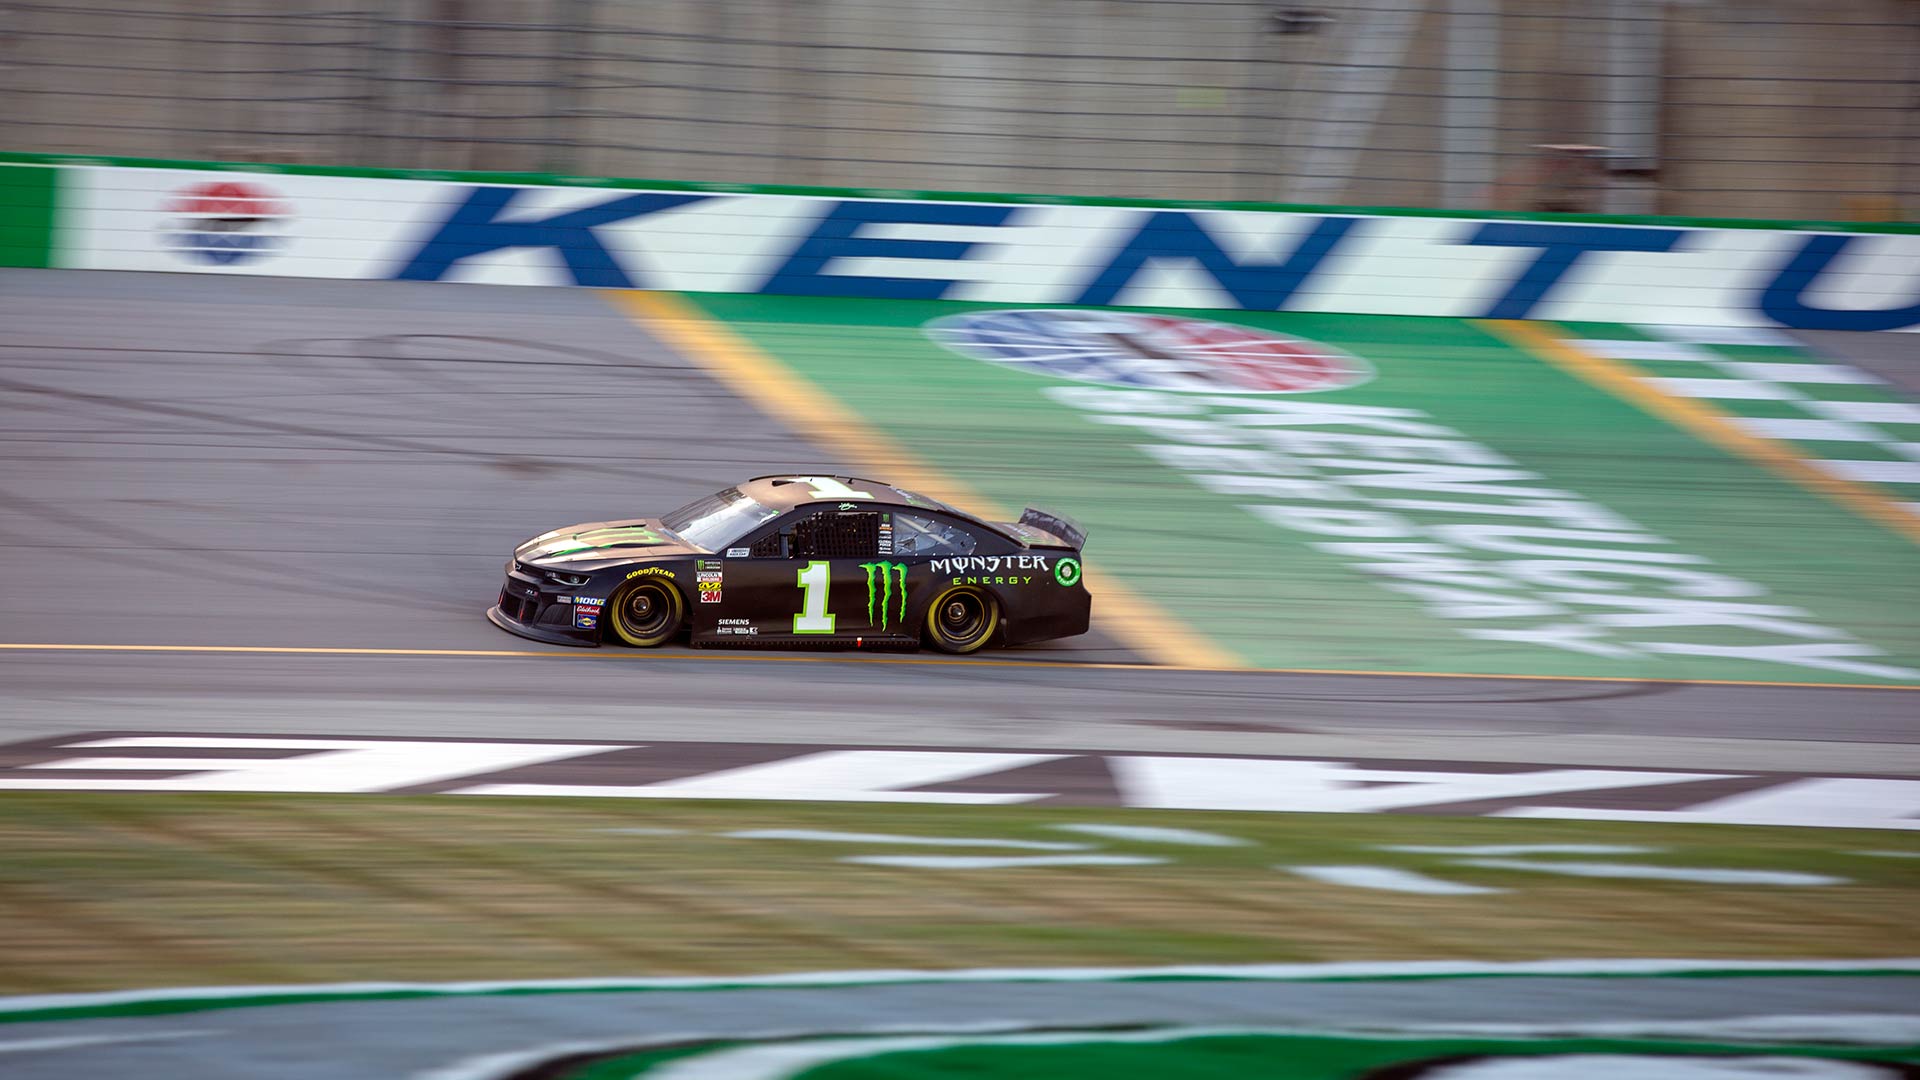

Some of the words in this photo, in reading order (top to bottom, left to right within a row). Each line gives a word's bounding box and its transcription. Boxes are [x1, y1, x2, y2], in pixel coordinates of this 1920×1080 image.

[787, 476, 875, 499] 1
[930, 555, 1049, 575] MONSTER
[626, 567, 675, 579] GOODYEAR
[952, 576, 1032, 586] ENERGY
[575, 596, 605, 606] MOOG
[702, 591, 720, 602] 3M
[793, 560, 836, 634] 1
